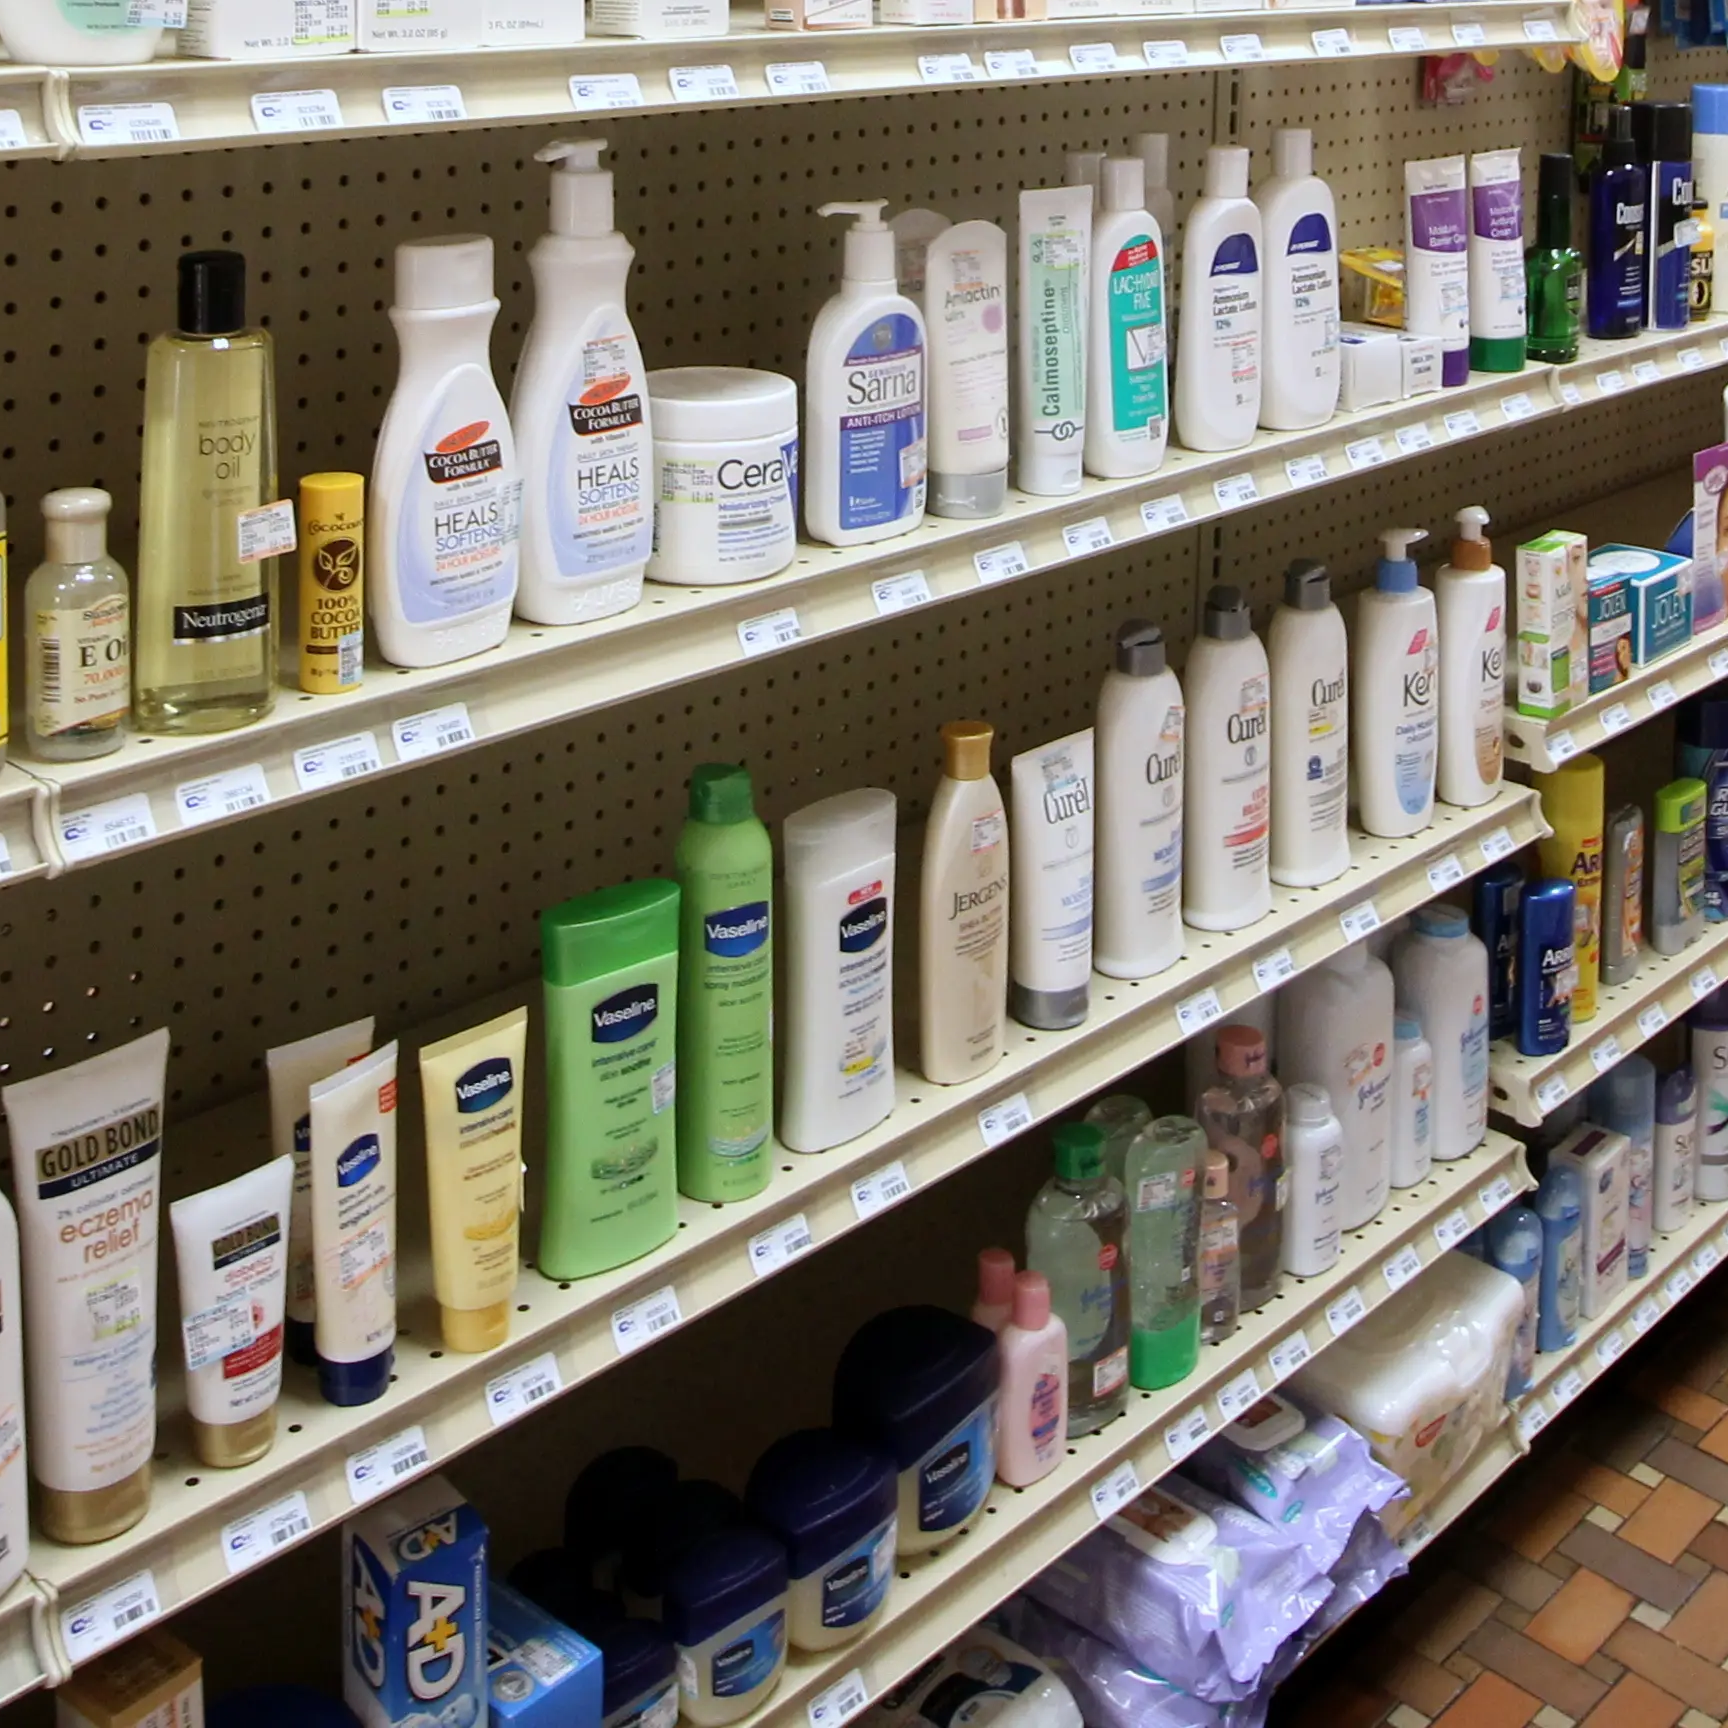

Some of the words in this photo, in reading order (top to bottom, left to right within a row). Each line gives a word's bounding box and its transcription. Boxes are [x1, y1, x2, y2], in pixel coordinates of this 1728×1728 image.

[1042, 285, 1060, 419] Calmoseptine
[847, 362, 917, 406] Sarna
[573, 404, 610, 422] COCOA
[611, 396, 639, 413] BUTTER
[846, 410, 894, 429] ANTI-ITCH
[896, 403, 921, 419] LOTION
[198, 431, 257, 459] body
[429, 451, 469, 470] COCOA
[468, 444, 500, 461] BUTTER
[215, 459, 242, 481] oil
[577, 458, 640, 490] HEALS
[578, 478, 640, 506] SOFTENS
[434, 503, 499, 537] HEALS
[436, 524, 501, 552] SOFTENS
[181, 604, 266, 630] Neutrogena
[310, 608, 362, 627] COCOA
[1597, 595, 1627, 619] JOLEN
[1653, 591, 1686, 630] JOLEN
[79, 644, 98, 668] E
[949, 876, 1009, 920] JERGENS
[706, 916, 769, 940] Vaseline
[840, 912, 887, 939] Vaseline
[593, 996, 658, 1029] Vaseline
[456, 1067, 512, 1099] Vaseline
[40, 1135, 99, 1180] GOLD
[102, 1108, 160, 1151] BOND
[338, 1142, 380, 1176] Vaseline
[60, 1189, 155, 1246] eczema
[83, 1223, 141, 1264] relief
